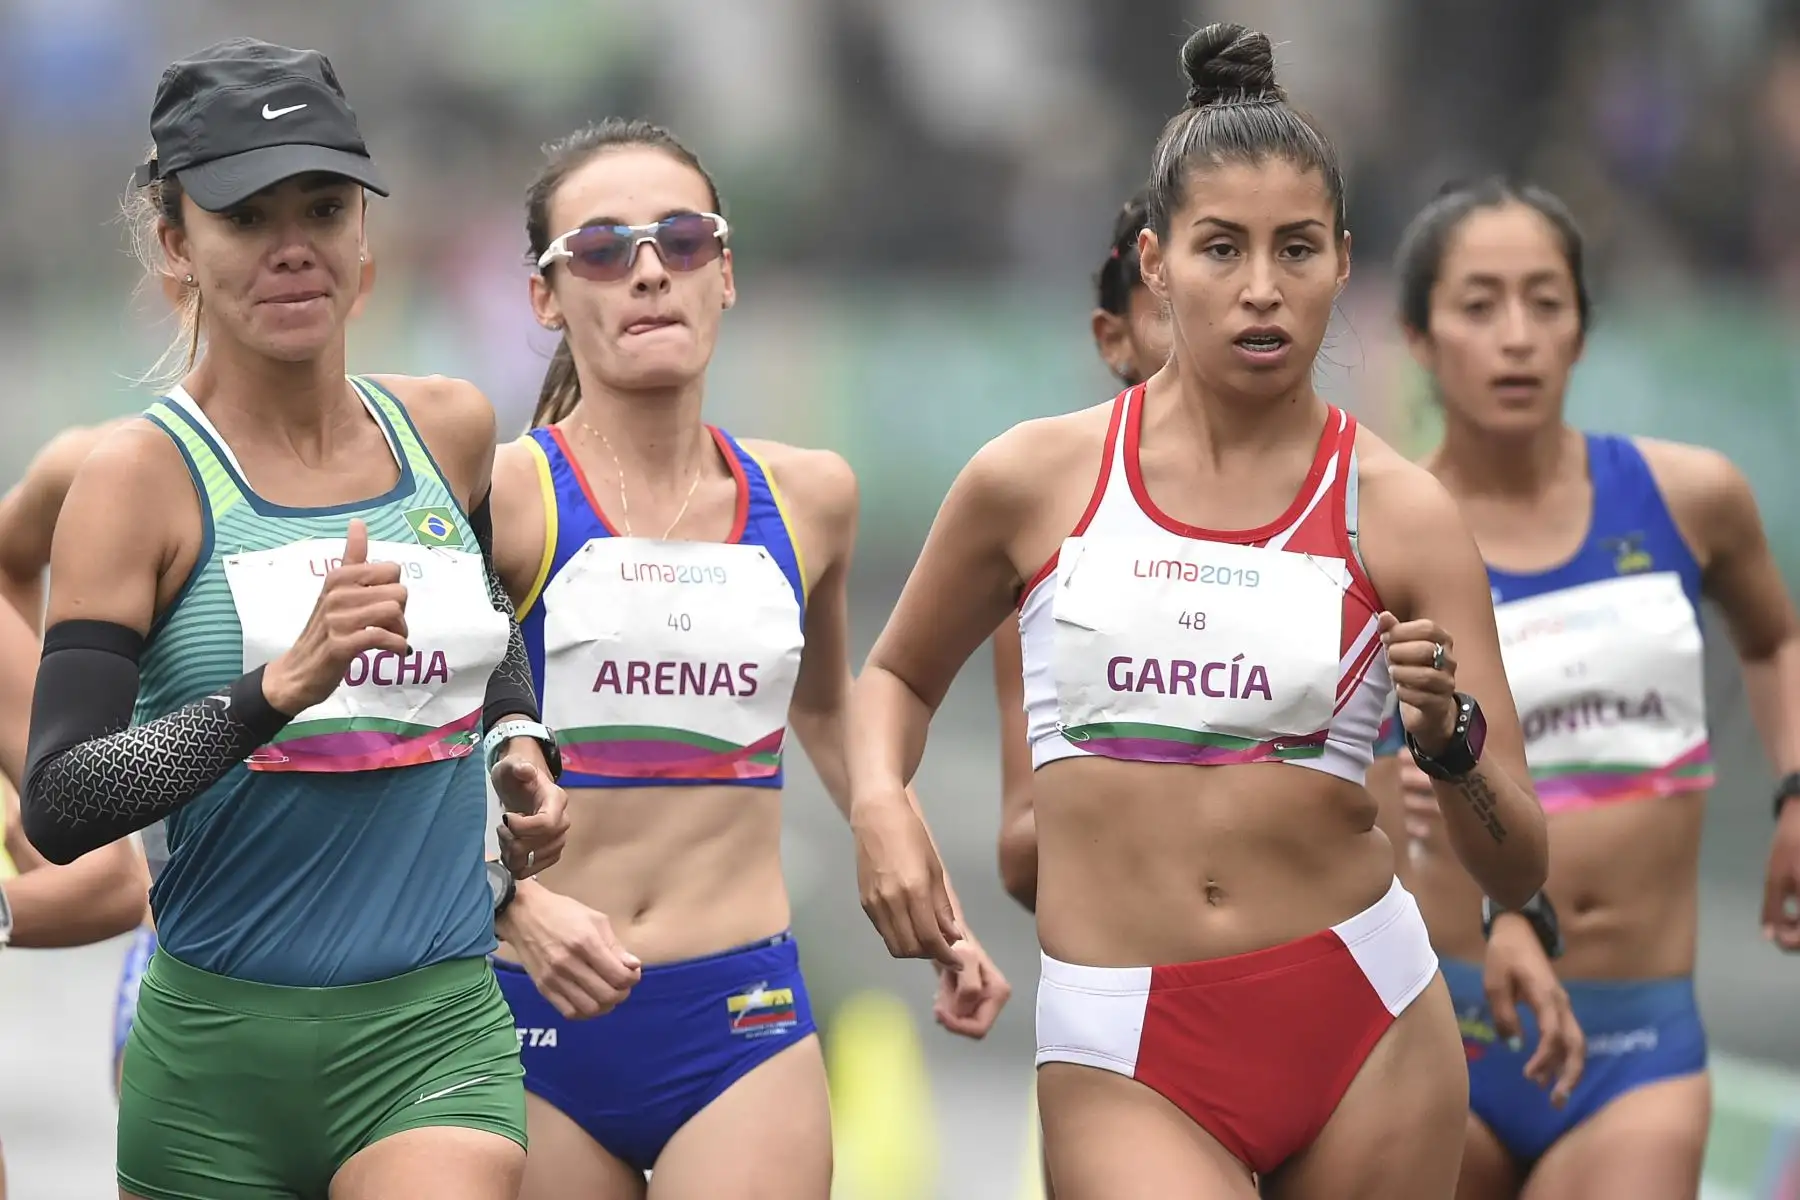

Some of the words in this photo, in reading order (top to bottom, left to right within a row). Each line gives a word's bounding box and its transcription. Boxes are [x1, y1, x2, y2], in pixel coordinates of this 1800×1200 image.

[667, 613, 691, 631] 40
[1178, 611, 1206, 630] 48
[344, 650, 448, 687] OCHA
[592, 660, 758, 697] ARENAS
[1107, 652, 1273, 700] GARCÍA
